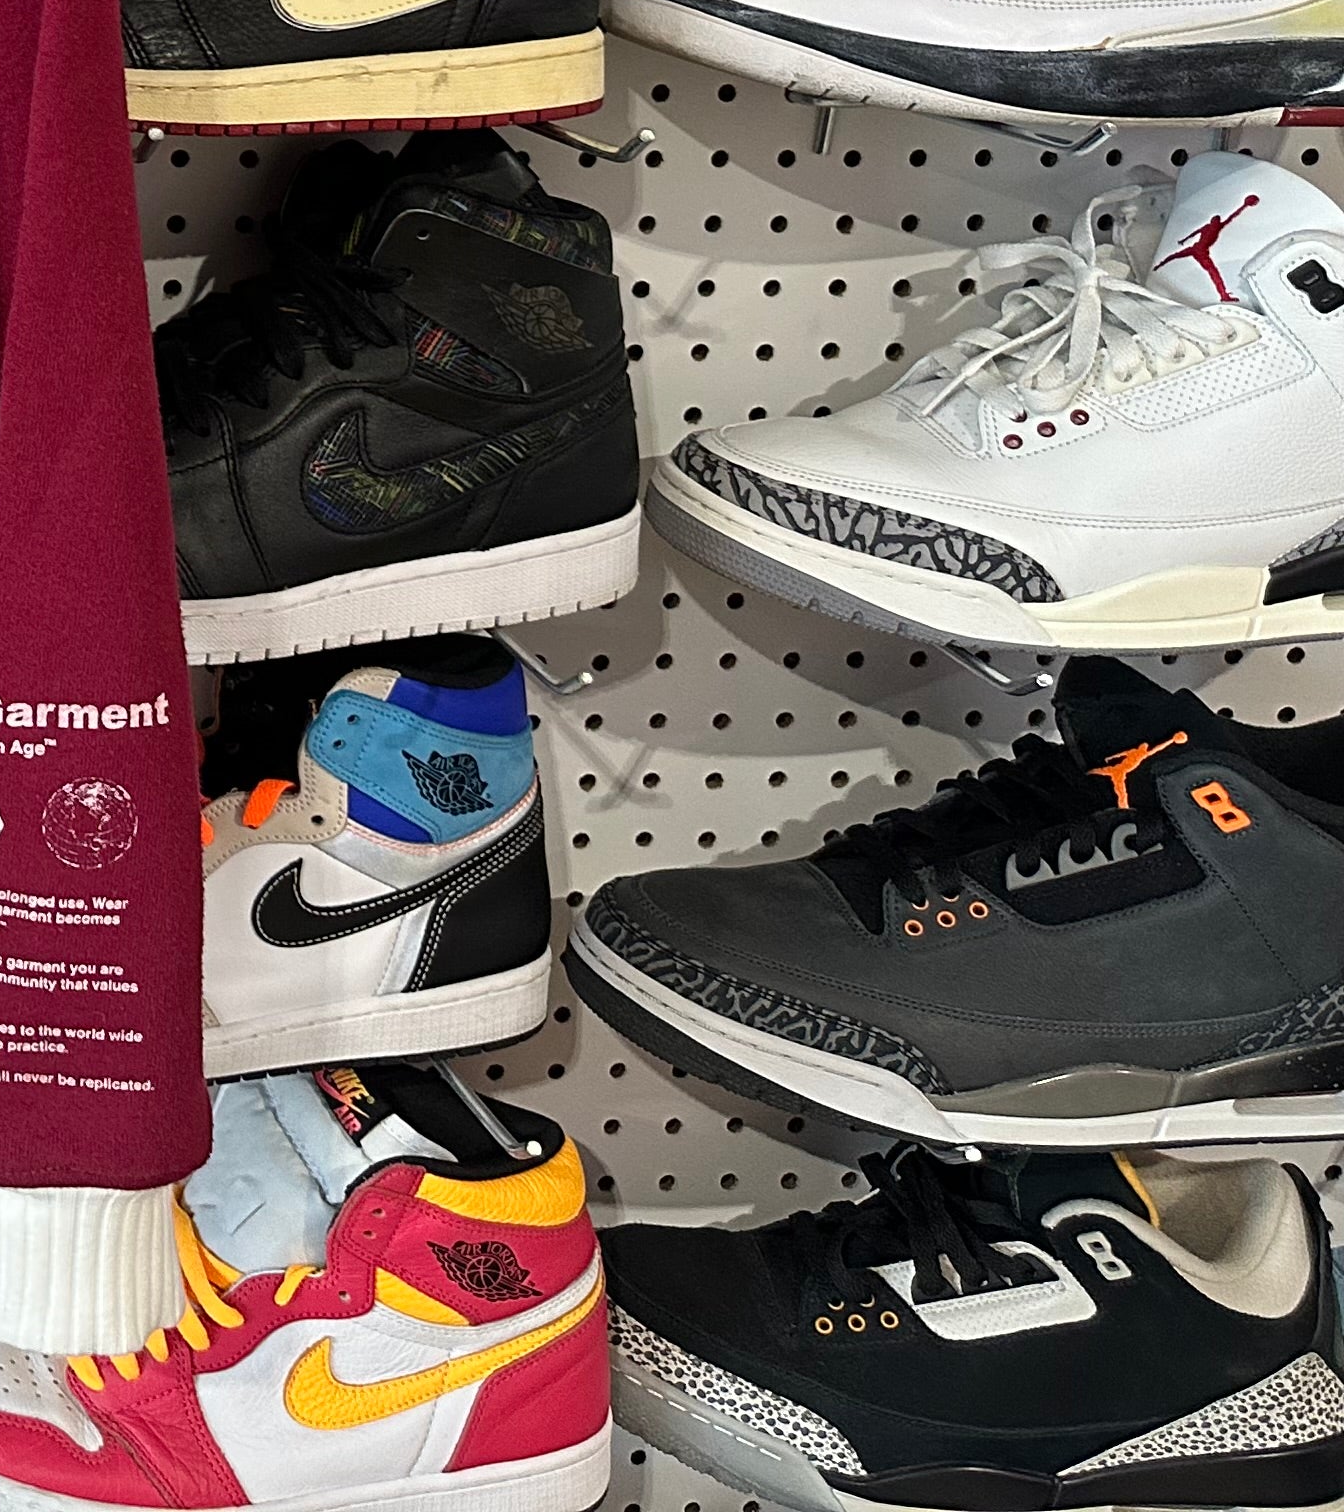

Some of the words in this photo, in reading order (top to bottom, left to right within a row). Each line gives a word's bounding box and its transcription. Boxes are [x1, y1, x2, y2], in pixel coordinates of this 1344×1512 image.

[58, 898, 89, 911] use,
[92, 896, 129, 911] Wear
[55, 911, 121, 926] becomes
[6, 957, 66, 973] garment
[69, 963, 97, 977] you
[99, 965, 124, 976] are
[60, 978, 89, 991] that
[91, 979, 140, 993] values
[20, 1025, 35, 1037] to
[38, 1024, 62, 1037] the
[64, 1028, 105, 1041] world
[108, 1029, 144, 1043] wide
[7, 1040, 69, 1054] practice.
[13, 1072, 54, 1084] never
[57, 1073, 76, 1087] be
[79, 1078, 155, 1092] replicated.
